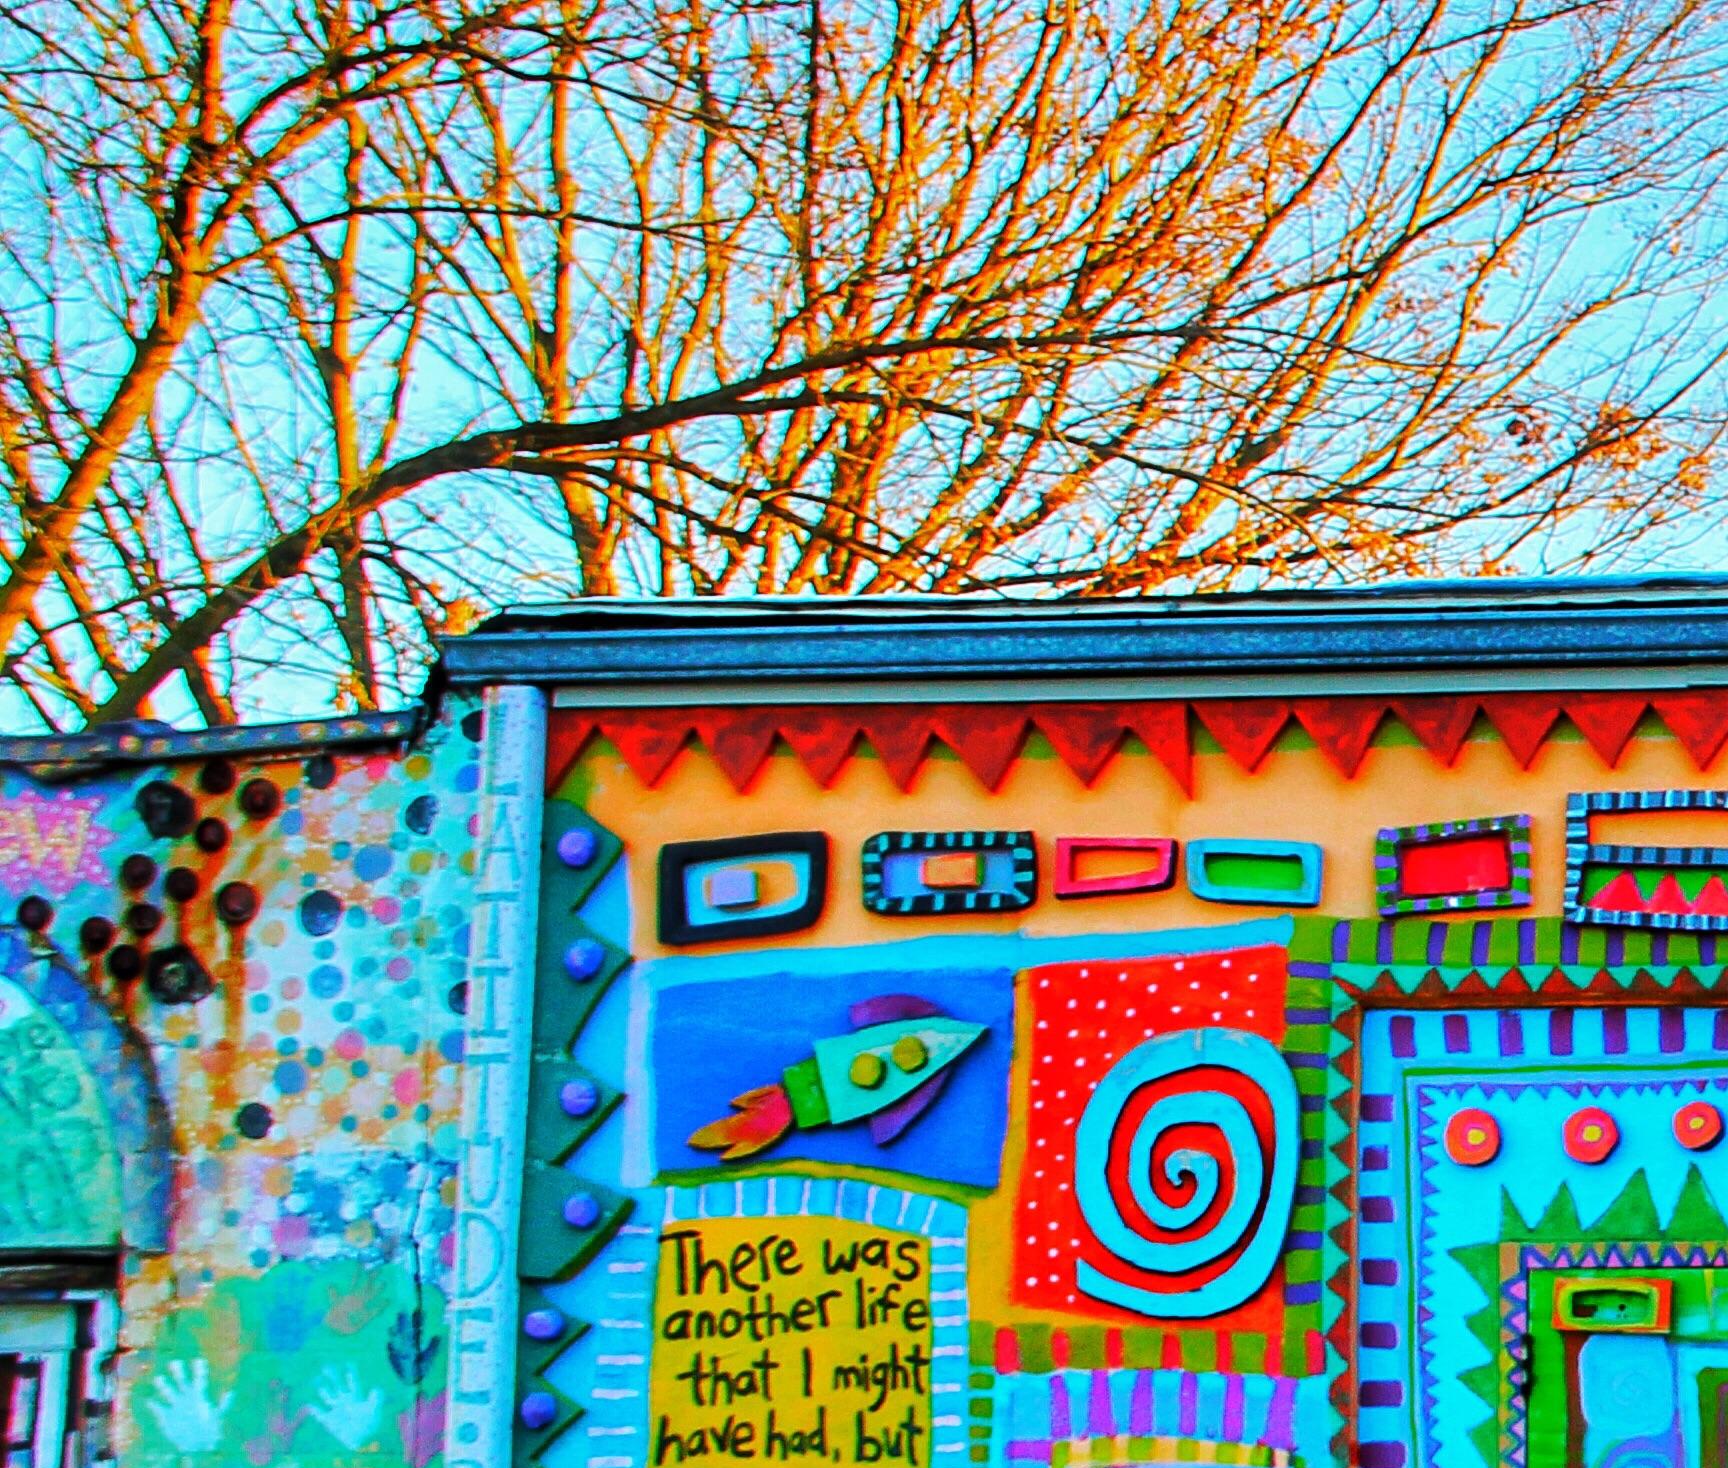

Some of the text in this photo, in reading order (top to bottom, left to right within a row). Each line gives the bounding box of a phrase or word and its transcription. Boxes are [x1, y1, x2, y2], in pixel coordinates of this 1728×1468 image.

[658, 1230, 922, 1296] There was
[662, 1277, 930, 1341] another life
[676, 1343, 931, 1412] that I might
[654, 1415, 756, 1466] have
[856, 1405, 923, 1466] but
